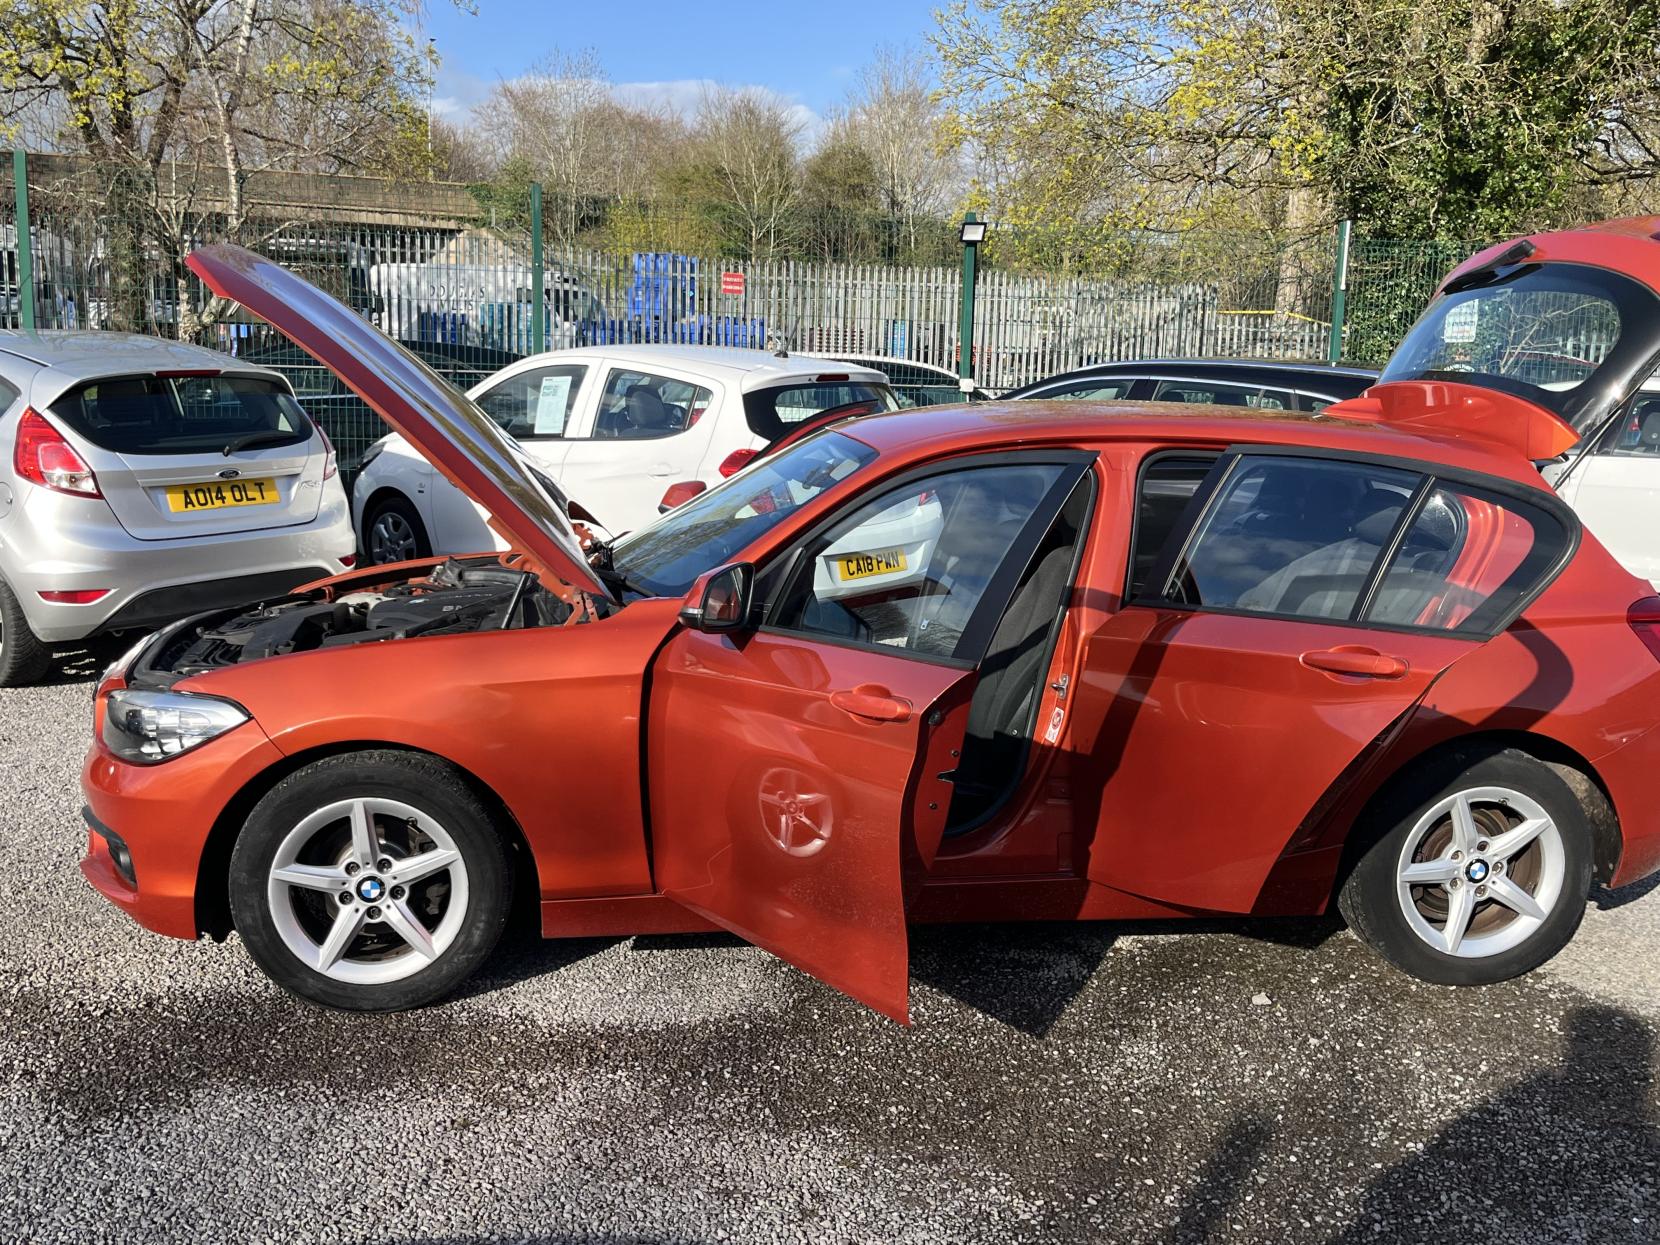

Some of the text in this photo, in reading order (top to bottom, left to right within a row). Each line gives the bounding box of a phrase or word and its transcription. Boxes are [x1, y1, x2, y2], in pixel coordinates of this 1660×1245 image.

[429, 285, 485, 298] DOUGAS
[183, 482, 265, 509] AO14 OLT
[846, 551, 900, 576] CA18 PWN
